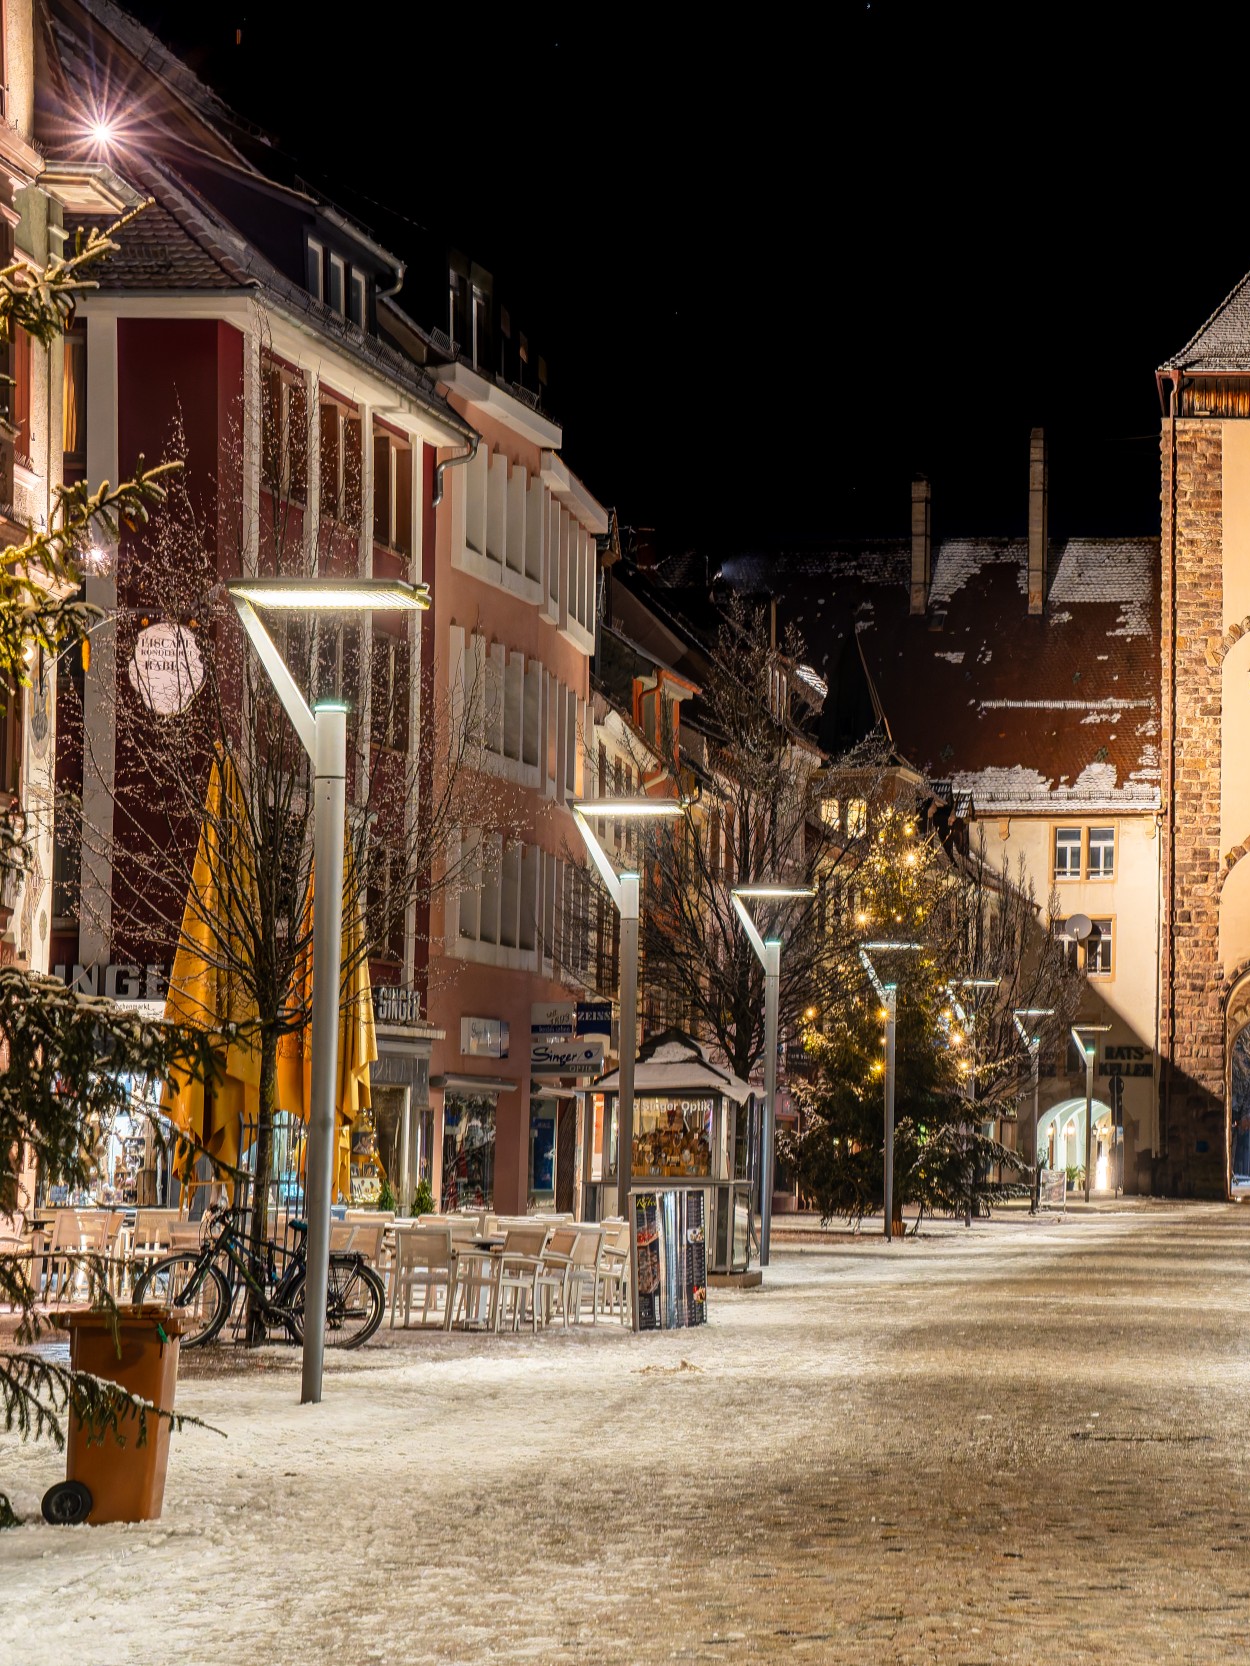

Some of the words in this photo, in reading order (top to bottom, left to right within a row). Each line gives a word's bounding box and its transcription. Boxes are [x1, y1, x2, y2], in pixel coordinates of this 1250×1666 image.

[55, 964, 174, 999] INGE
[577, 1011, 611, 1021] ZEISS
[531, 1046, 578, 1067] Singer
[642, 1101, 679, 1112] Singer
[681, 1101, 711, 1113] Optik
